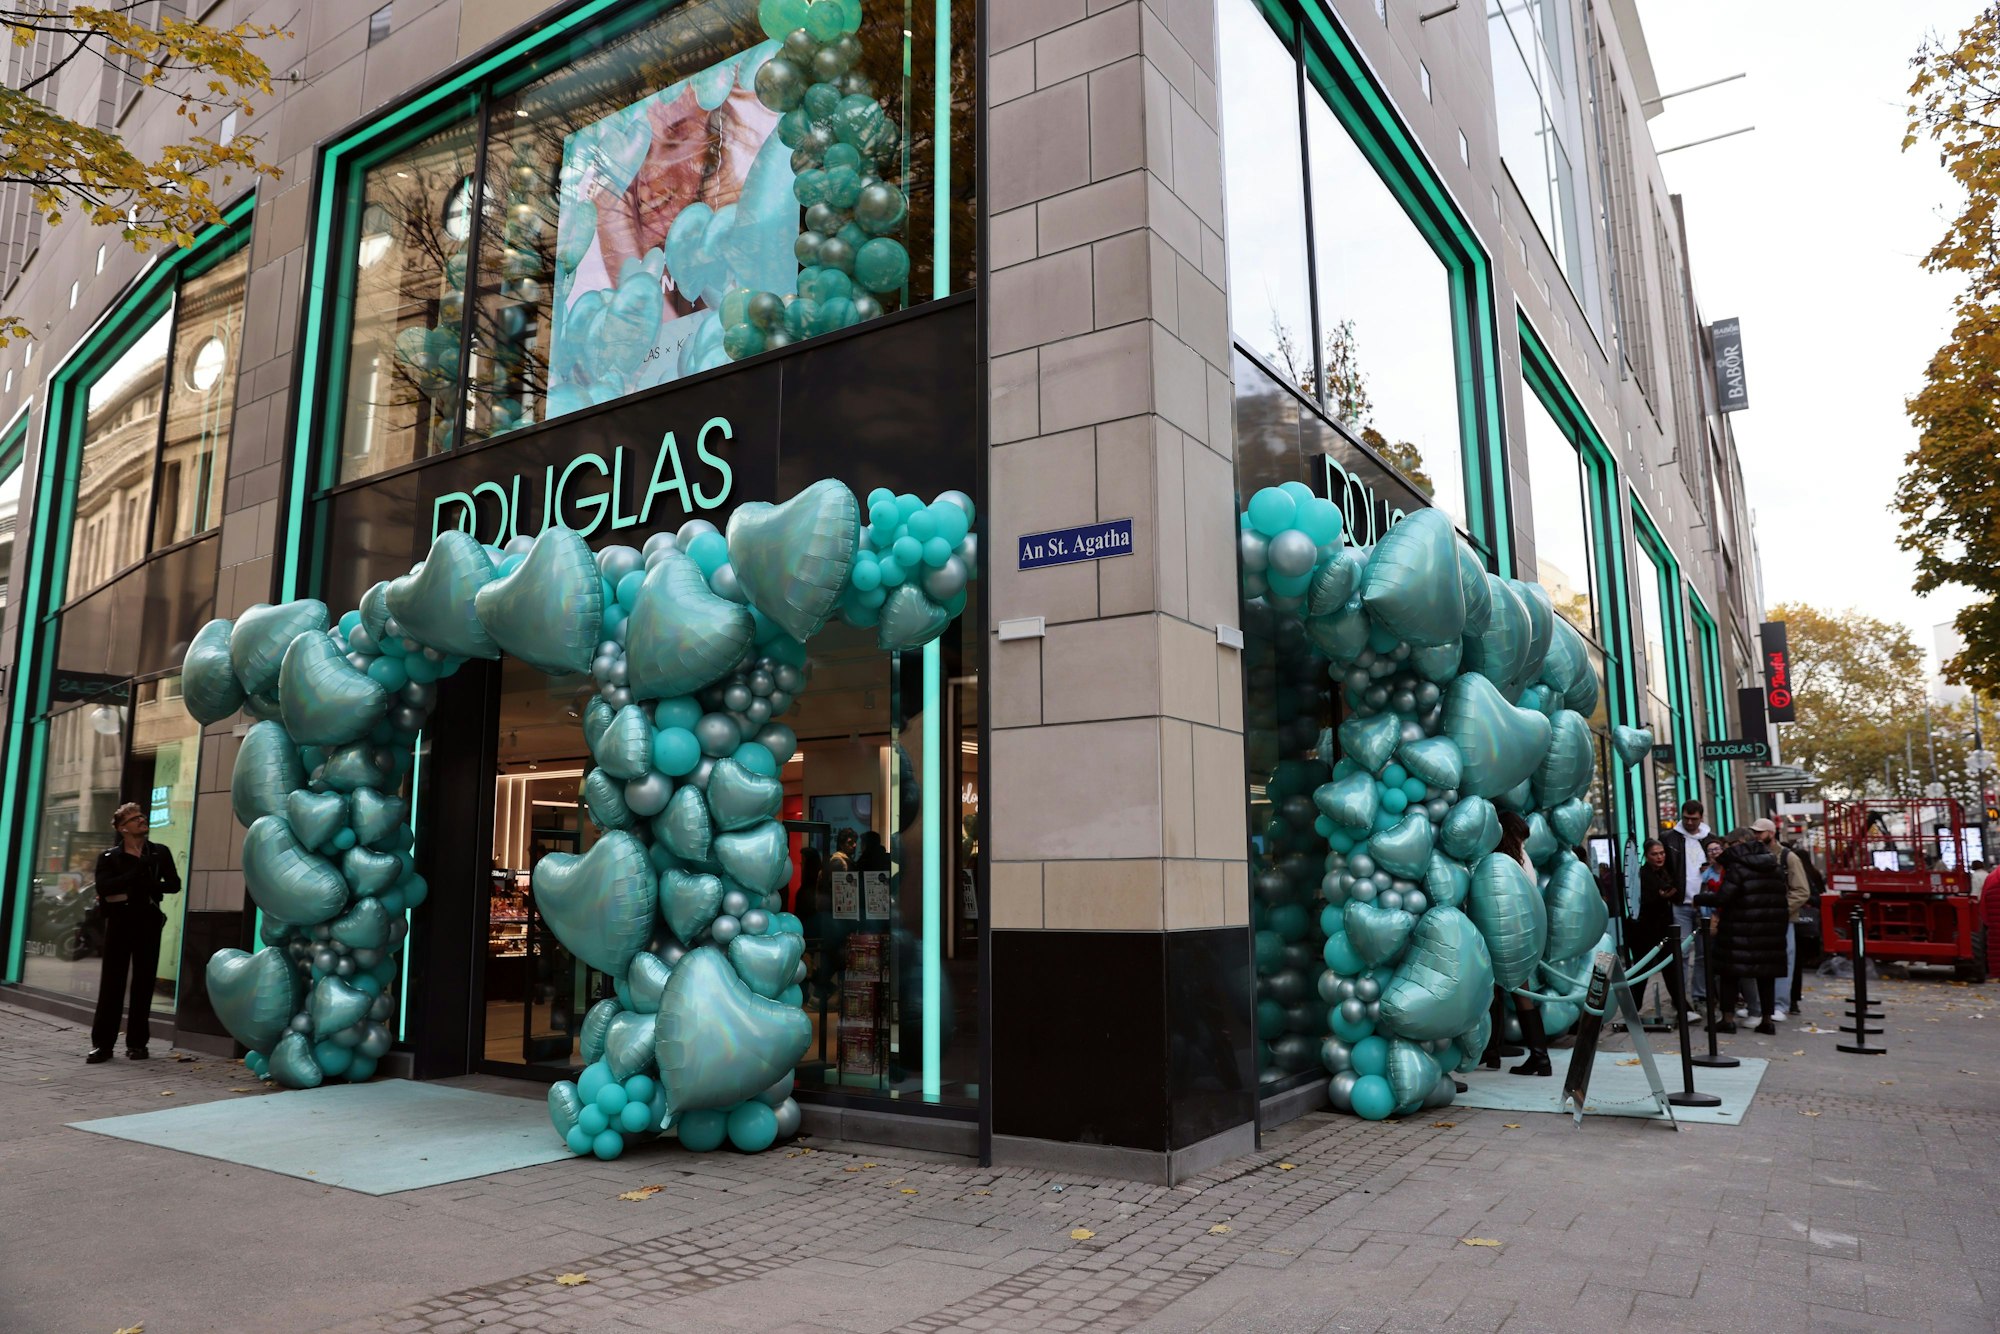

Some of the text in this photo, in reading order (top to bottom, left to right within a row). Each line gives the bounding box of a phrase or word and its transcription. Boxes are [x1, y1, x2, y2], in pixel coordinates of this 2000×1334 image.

[1724, 344, 1744, 398] BABOR
[1021, 528, 1130, 561] An St. Agatha
[1705, 744, 1753, 756] DOUGLAS
